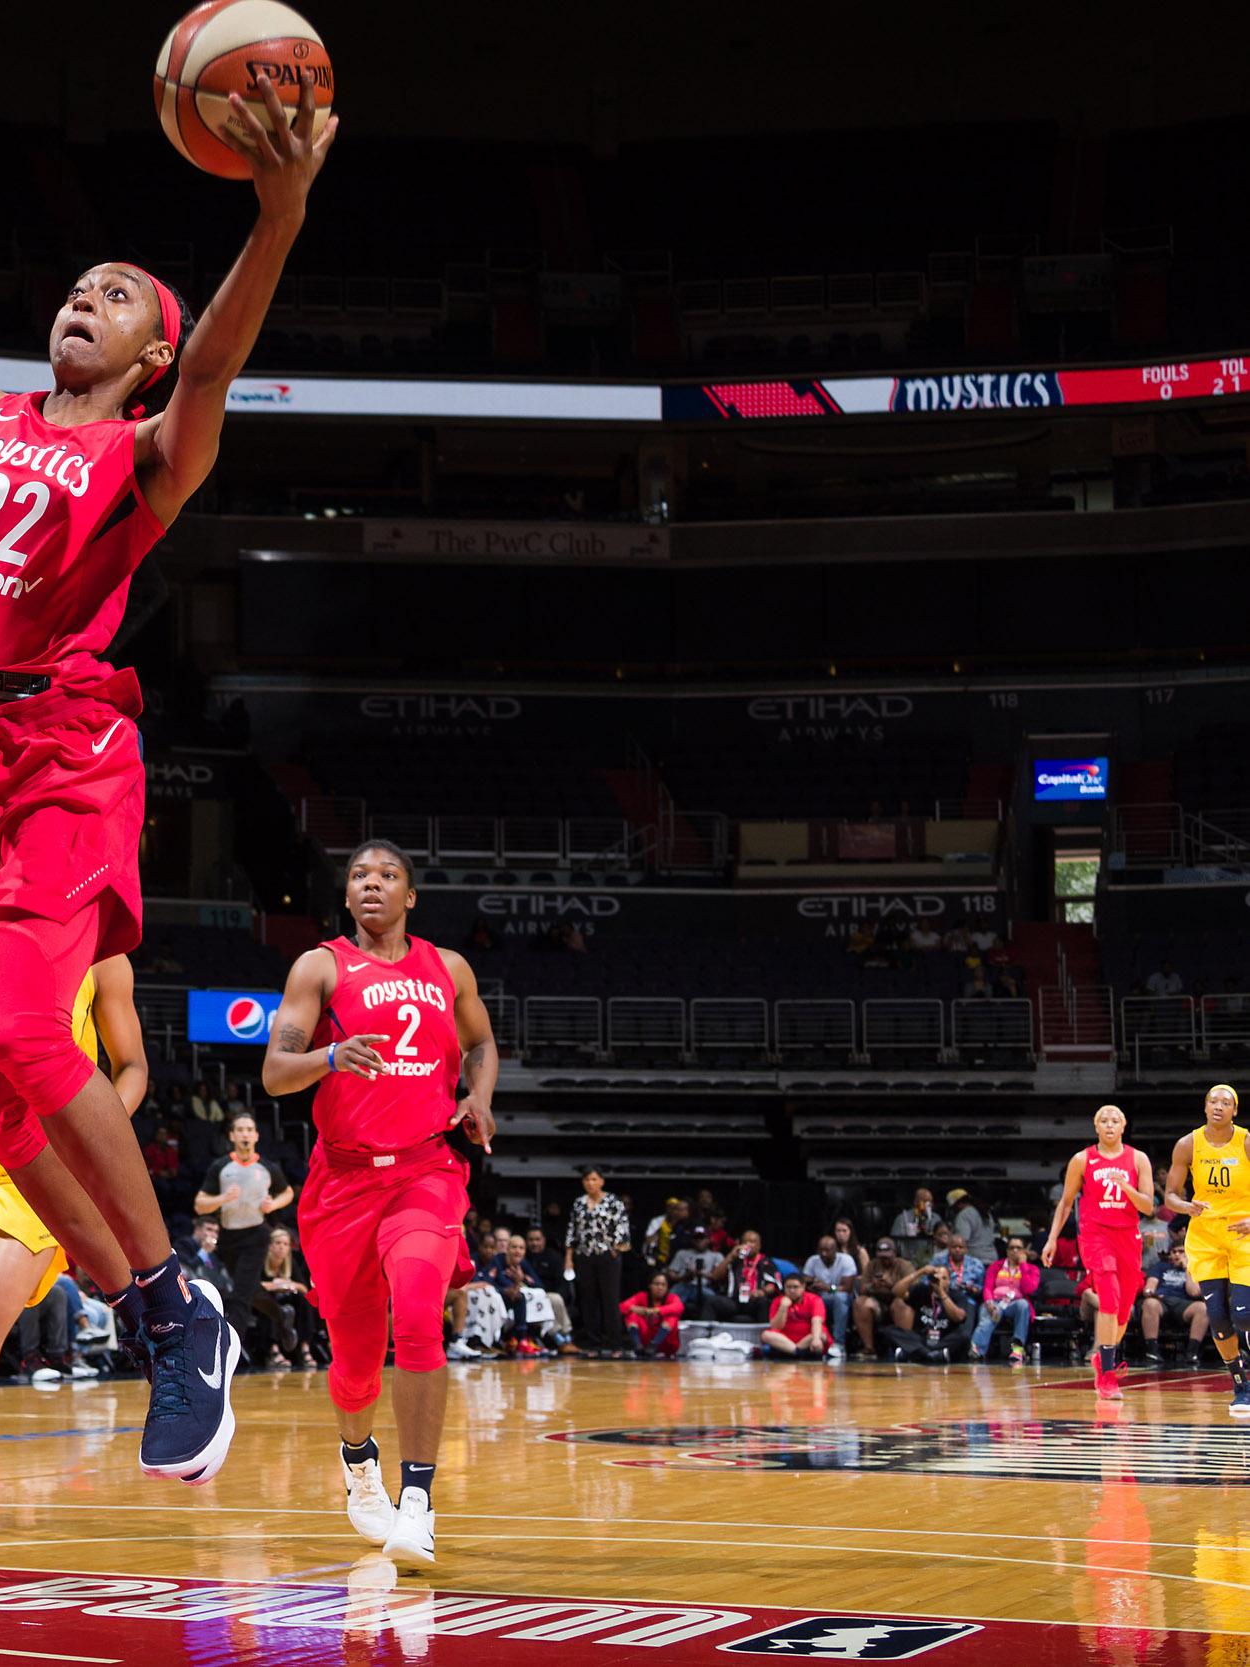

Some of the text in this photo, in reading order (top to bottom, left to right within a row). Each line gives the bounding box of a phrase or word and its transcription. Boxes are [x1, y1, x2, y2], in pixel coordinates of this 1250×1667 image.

[1142, 358, 1248, 384] FOULS TOL
[1160, 383, 1173, 400] 0
[428, 530, 606, 554] The PwC Club
[360, 695, 522, 719] ETIHAD
[747, 696, 913, 719] ETIHAD
[988, 693, 1019, 709] 118
[1145, 689, 1174, 705] 117
[477, 894, 621, 916] ETIHAD
[797, 895, 996, 918] ETIHAD 118
[395, 1004, 421, 1056] 2
[1208, 1166, 1230, 1188] 40
[1102, 1179, 1122, 1201] 21
